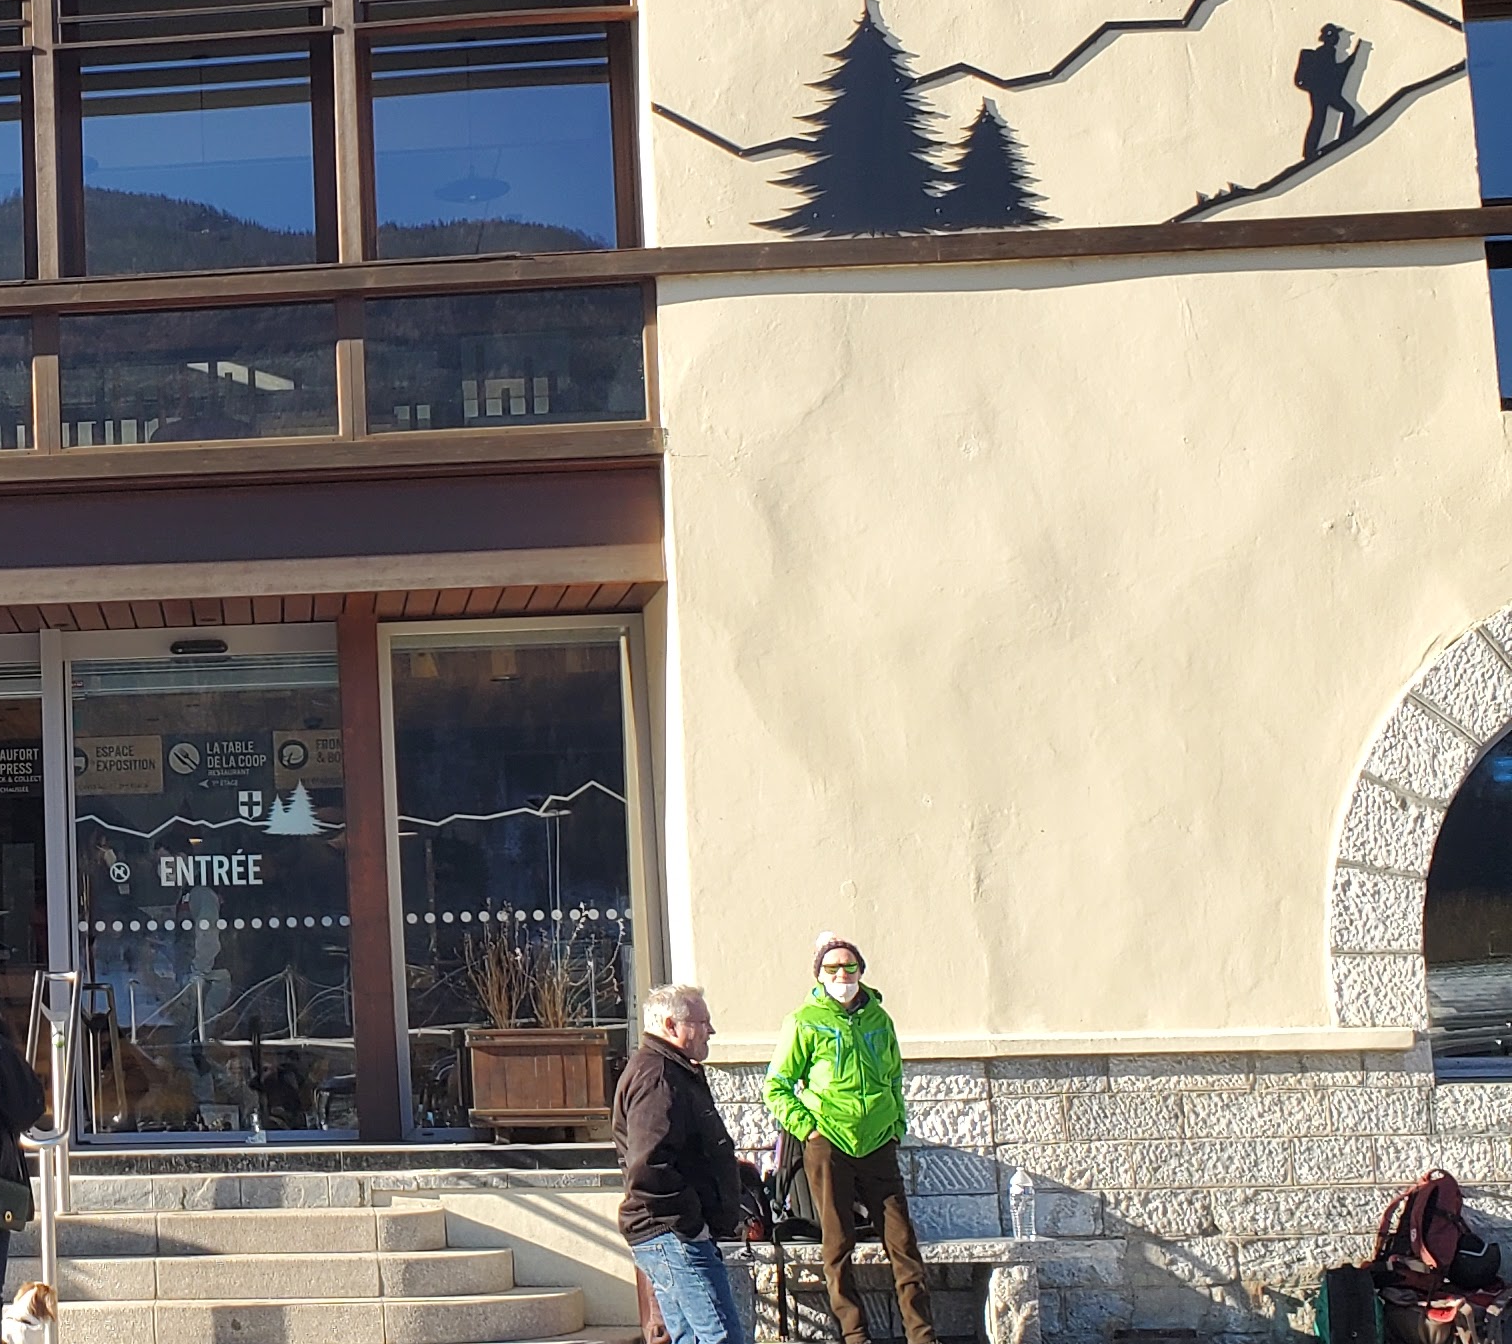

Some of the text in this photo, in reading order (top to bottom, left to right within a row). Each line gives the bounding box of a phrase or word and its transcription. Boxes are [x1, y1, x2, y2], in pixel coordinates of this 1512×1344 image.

[96, 745, 135, 758] ESPACE
[206, 741, 254, 754] LA TABLE
[96, 759, 156, 772] EXPOSITION
[207, 754, 267, 768] DE LA COOP
[160, 848, 264, 887] ENTRÉE
